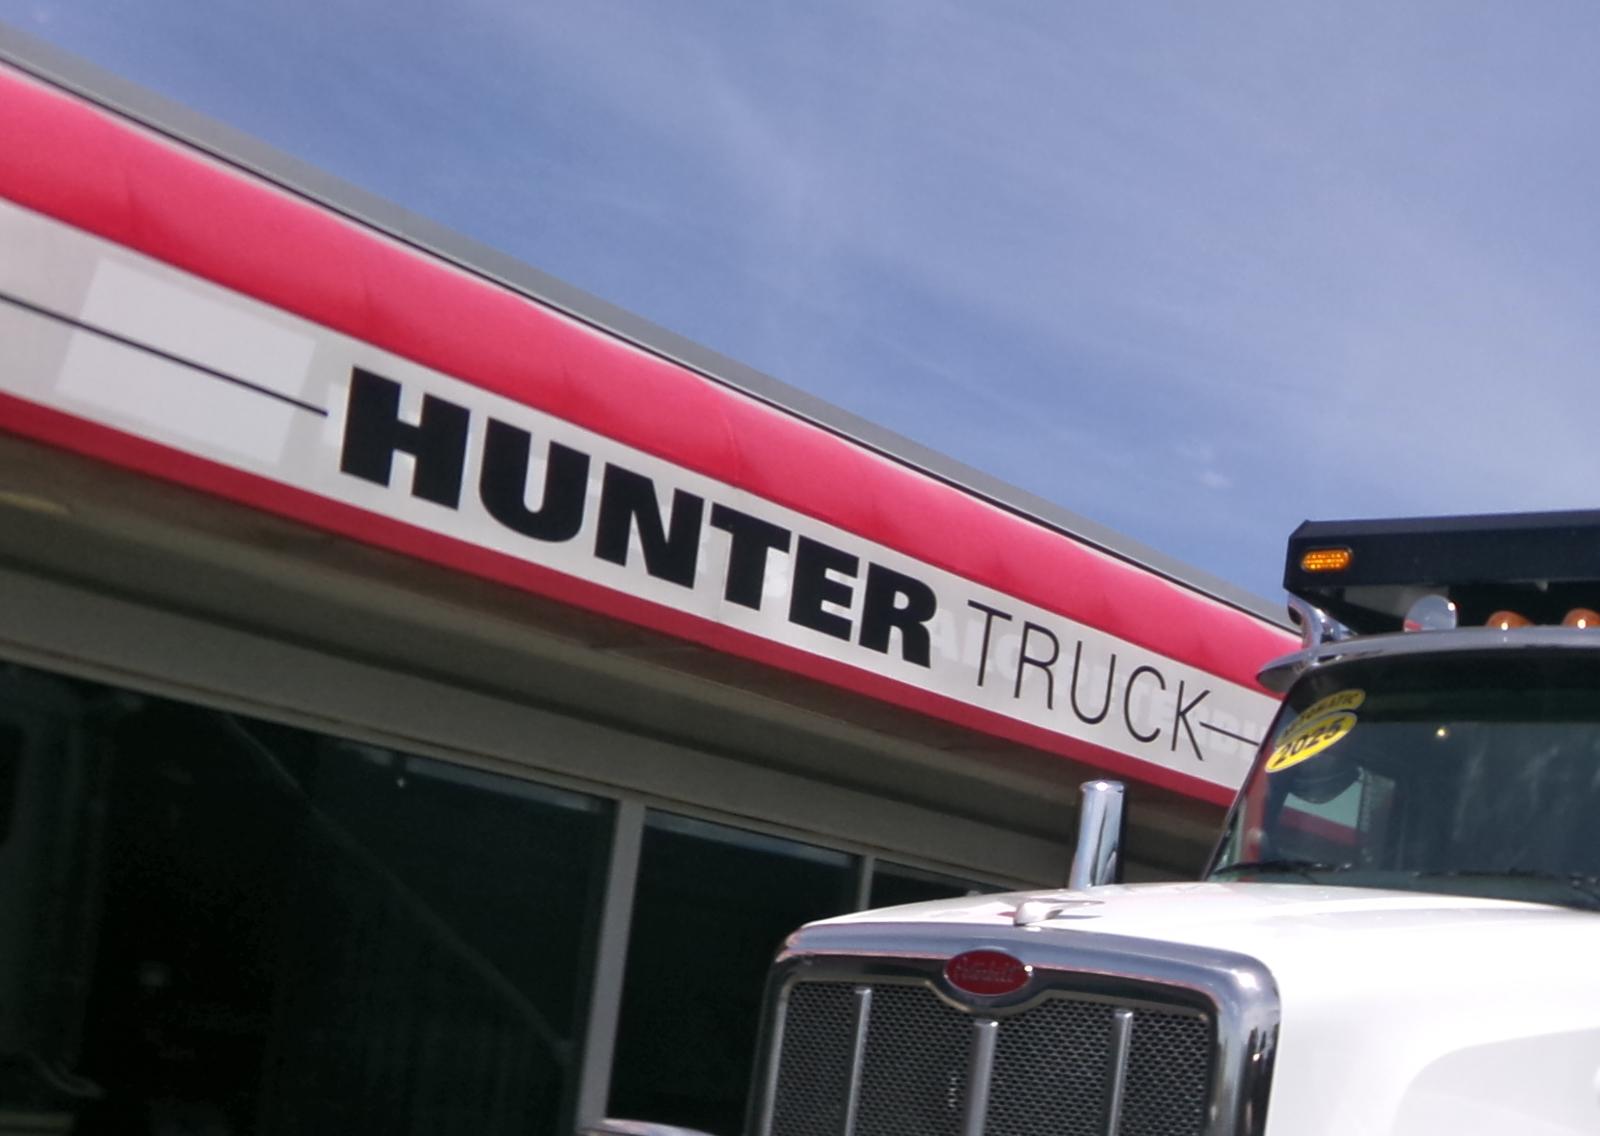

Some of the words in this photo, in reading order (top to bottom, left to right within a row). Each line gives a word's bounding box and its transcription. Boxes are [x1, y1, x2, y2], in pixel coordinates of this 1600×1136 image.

[340, 365, 938, 669] HUNTER
[967, 599, 1210, 762] TRUCK
[1271, 716, 1347, 769] 2025
